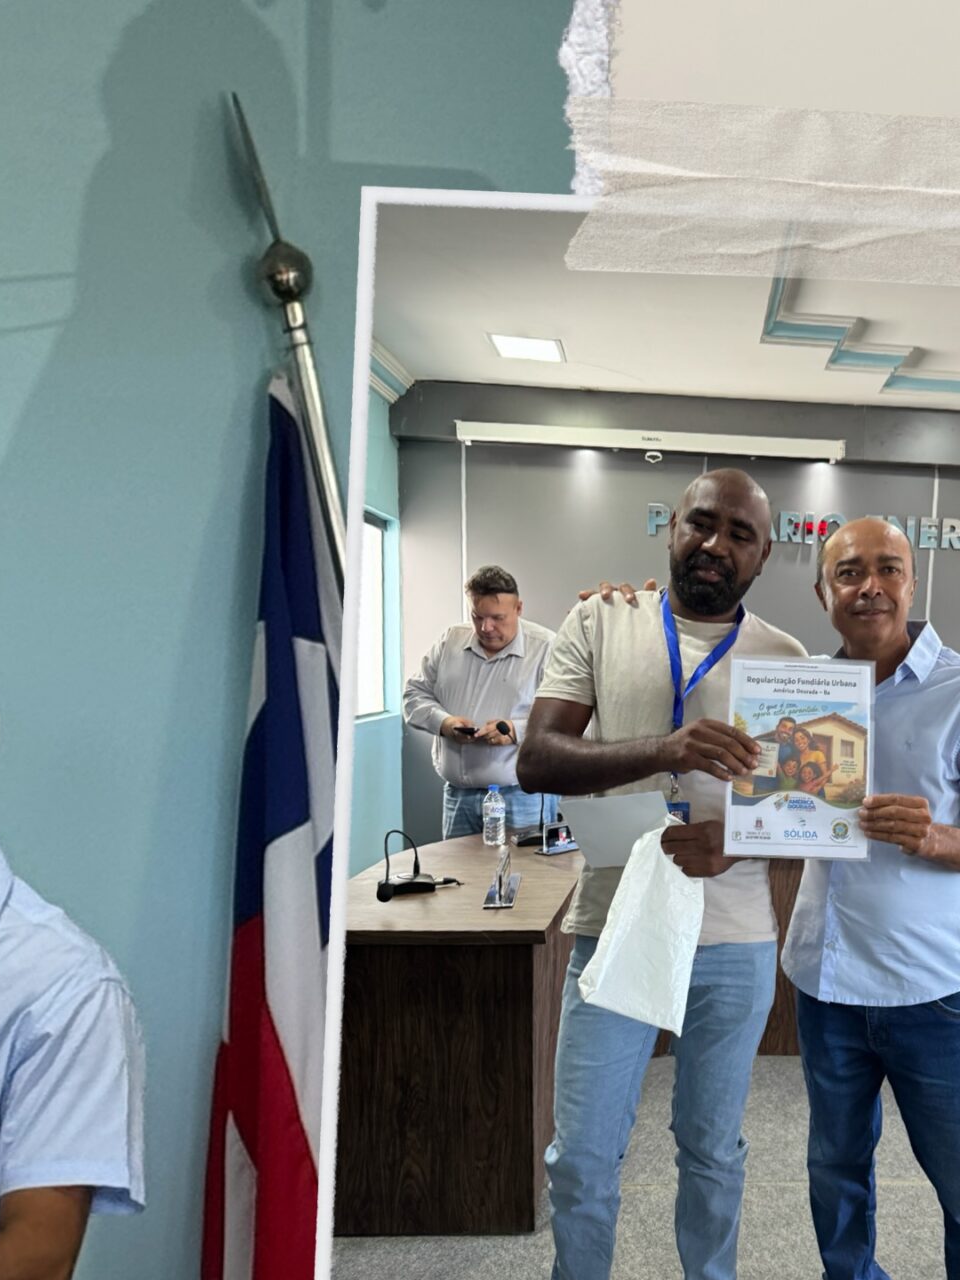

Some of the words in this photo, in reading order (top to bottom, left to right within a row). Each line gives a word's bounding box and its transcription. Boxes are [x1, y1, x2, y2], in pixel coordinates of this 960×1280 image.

[746, 675, 796, 687] Regularização
[797, 677, 830, 687] Fundiária
[831, 679, 857, 688] Urbana
[783, 828, 818, 839] SÓLIDA
